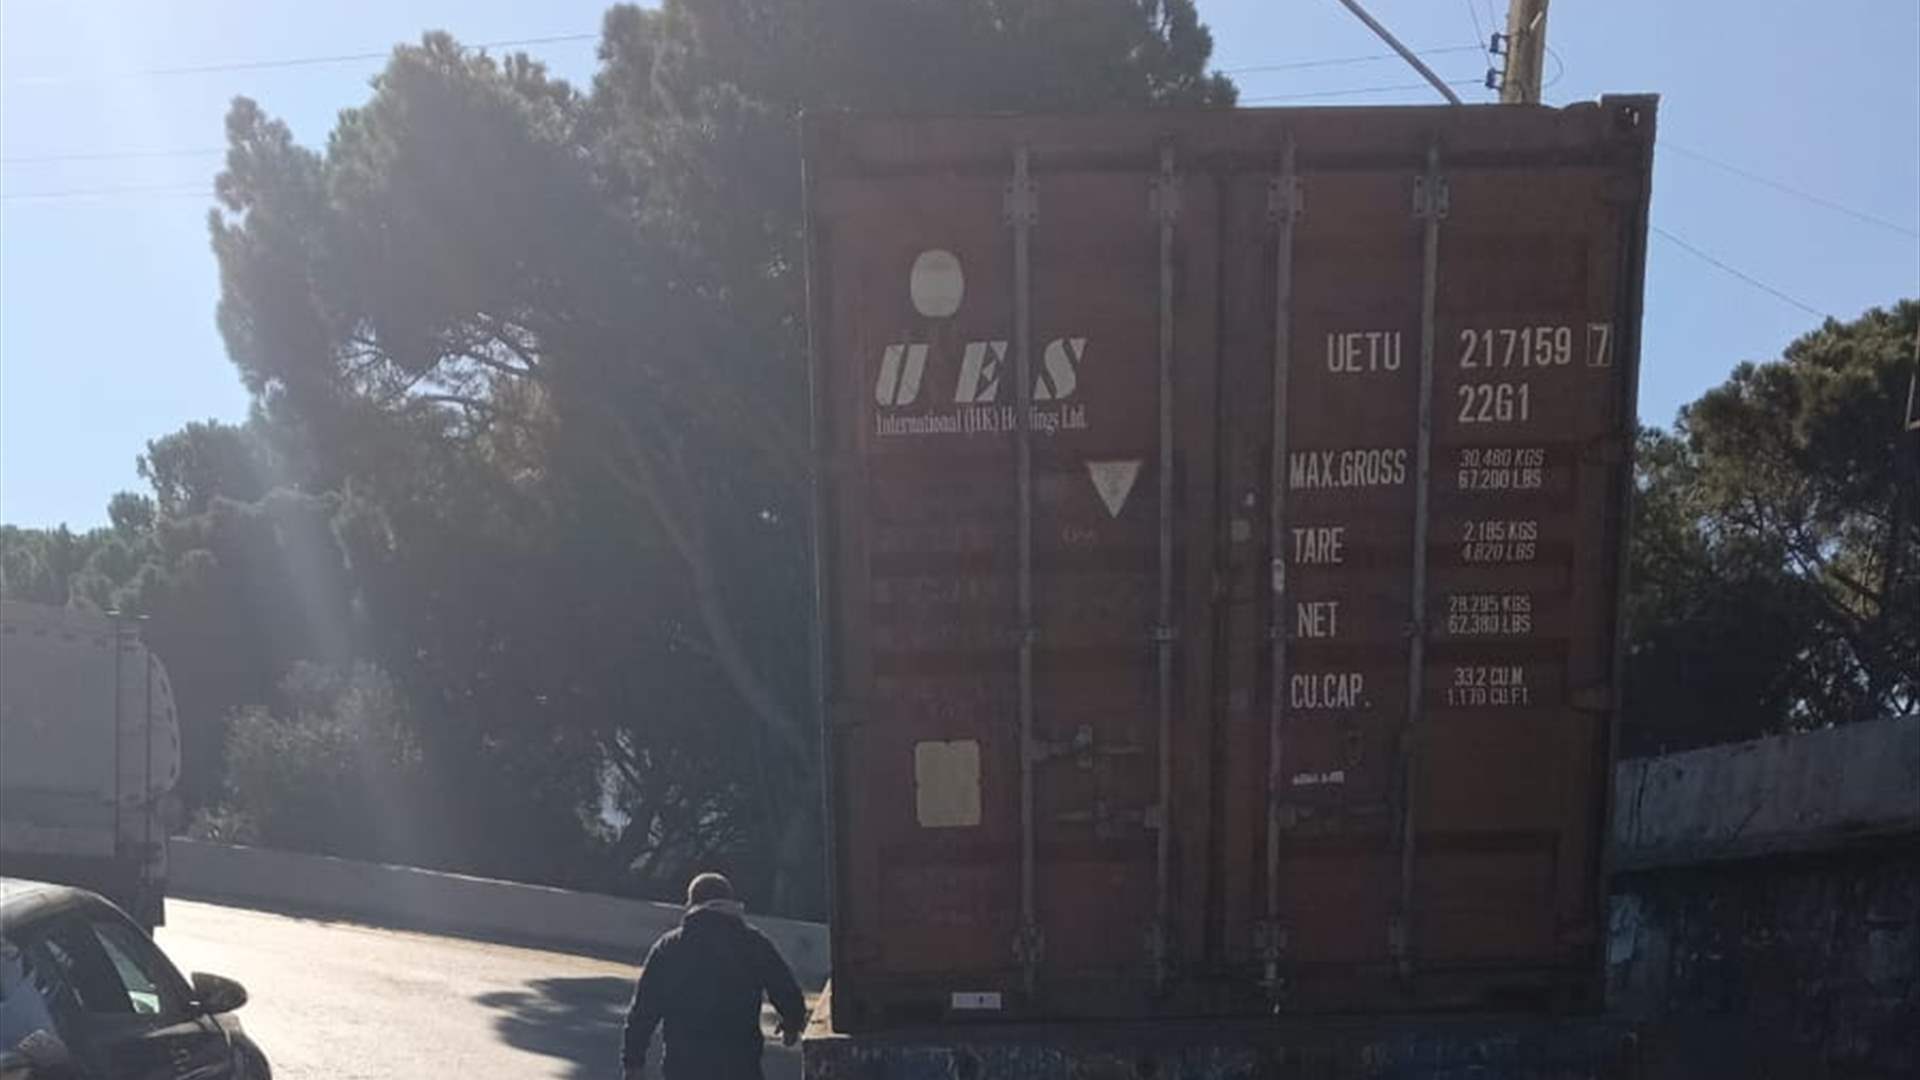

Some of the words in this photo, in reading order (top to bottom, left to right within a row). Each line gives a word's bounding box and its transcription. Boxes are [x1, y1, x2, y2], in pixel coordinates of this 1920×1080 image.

[1326, 331, 1401, 372] UETU
[1458, 325, 1573, 368] 217159
[1591, 323, 1609, 367] 7
[1456, 381, 1530, 423] 22G1
[875, 408, 960, 435] International
[963, 405, 999, 437] (HK)
[1289, 447, 1408, 491] MAX.GROSS
[1514, 448, 1545, 467] KGS
[1512, 468, 1542, 488] LBS
[1291, 527, 1345, 563] TARE
[1507, 519, 1538, 540] KGS
[1505, 541, 1536, 560] LBS
[1297, 601, 1340, 638] NET
[1501, 613, 1532, 634] LBS
[1290, 672, 1373, 709] CU.CAP.
